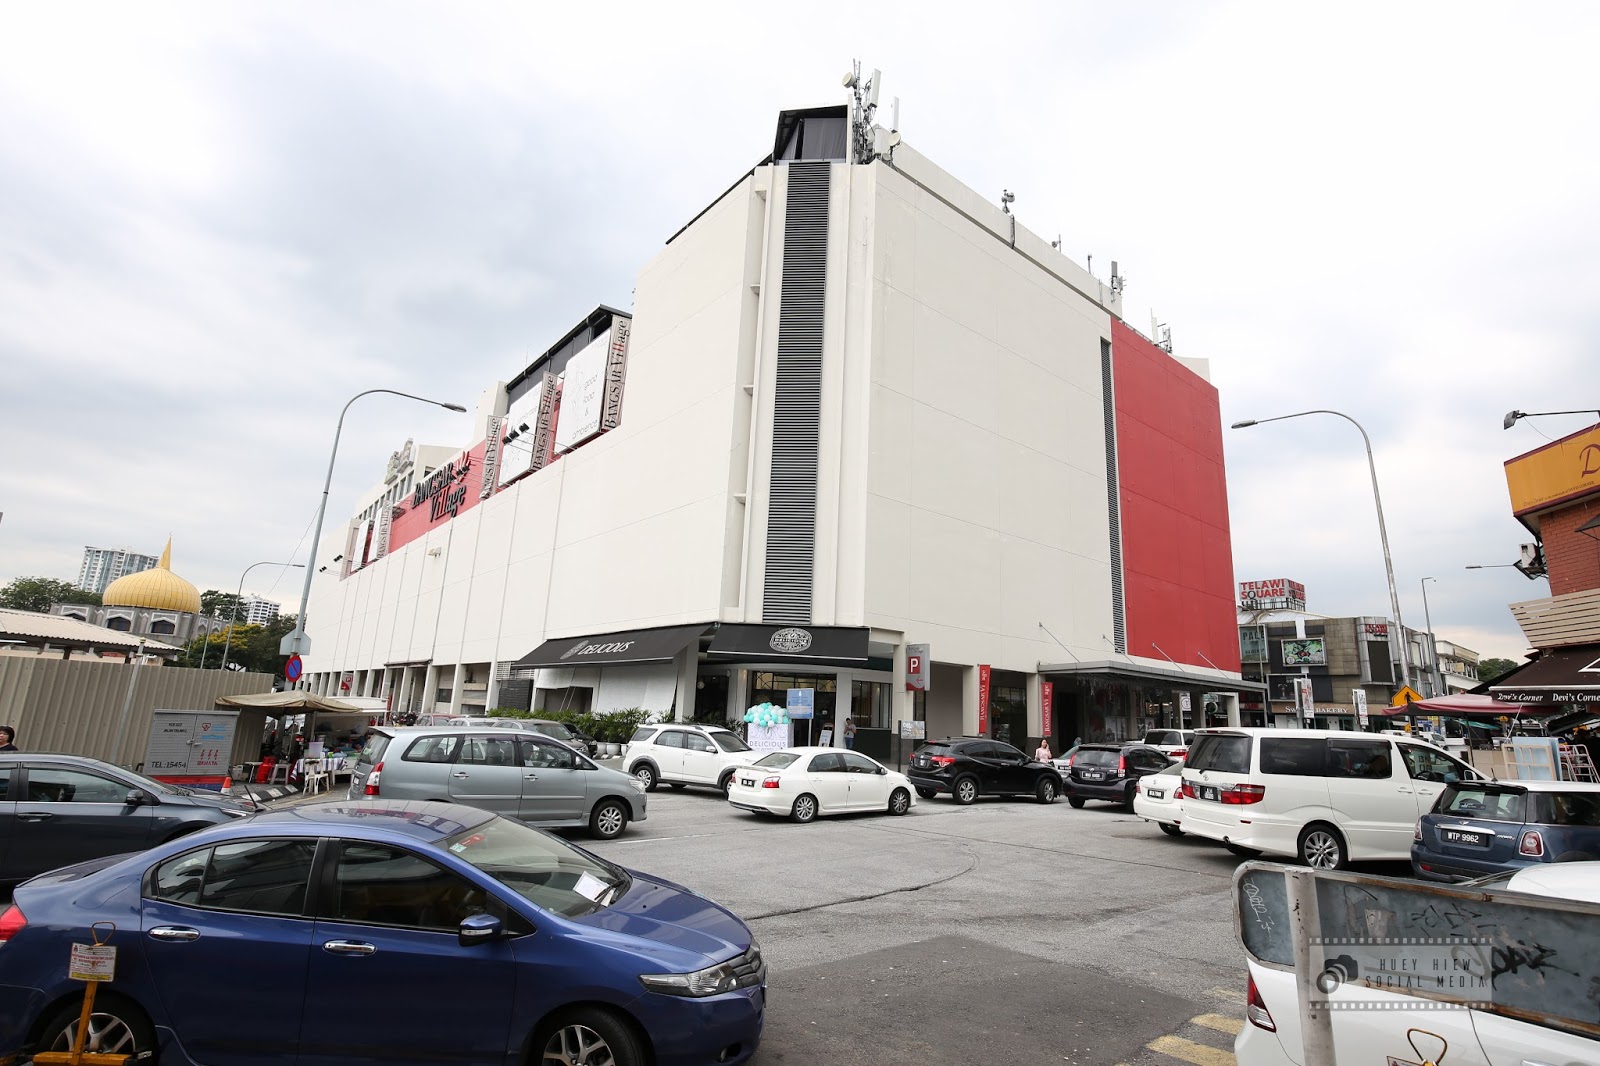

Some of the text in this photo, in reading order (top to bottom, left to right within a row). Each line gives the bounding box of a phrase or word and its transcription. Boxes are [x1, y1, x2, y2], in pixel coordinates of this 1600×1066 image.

[604, 320, 630, 429] BANGSAR Village
[532, 375, 556, 470] BANGSAR Village
[412, 462, 456, 509] BANGSAR
[430, 485, 466, 523] Village
[1241, 579, 1285, 590] TELAWI
[1241, 588, 1285, 600] SQUARE
[577, 641, 635, 655] DELICIOUS
[910, 658, 919, 673] P
[1518, 693, 1543, 702] Corner
[1552, 692, 1600, 702] Devi's Corne
[749, 740, 786, 748] DELICIOUS
[1447, 831, 1479, 843] WTP 9962
